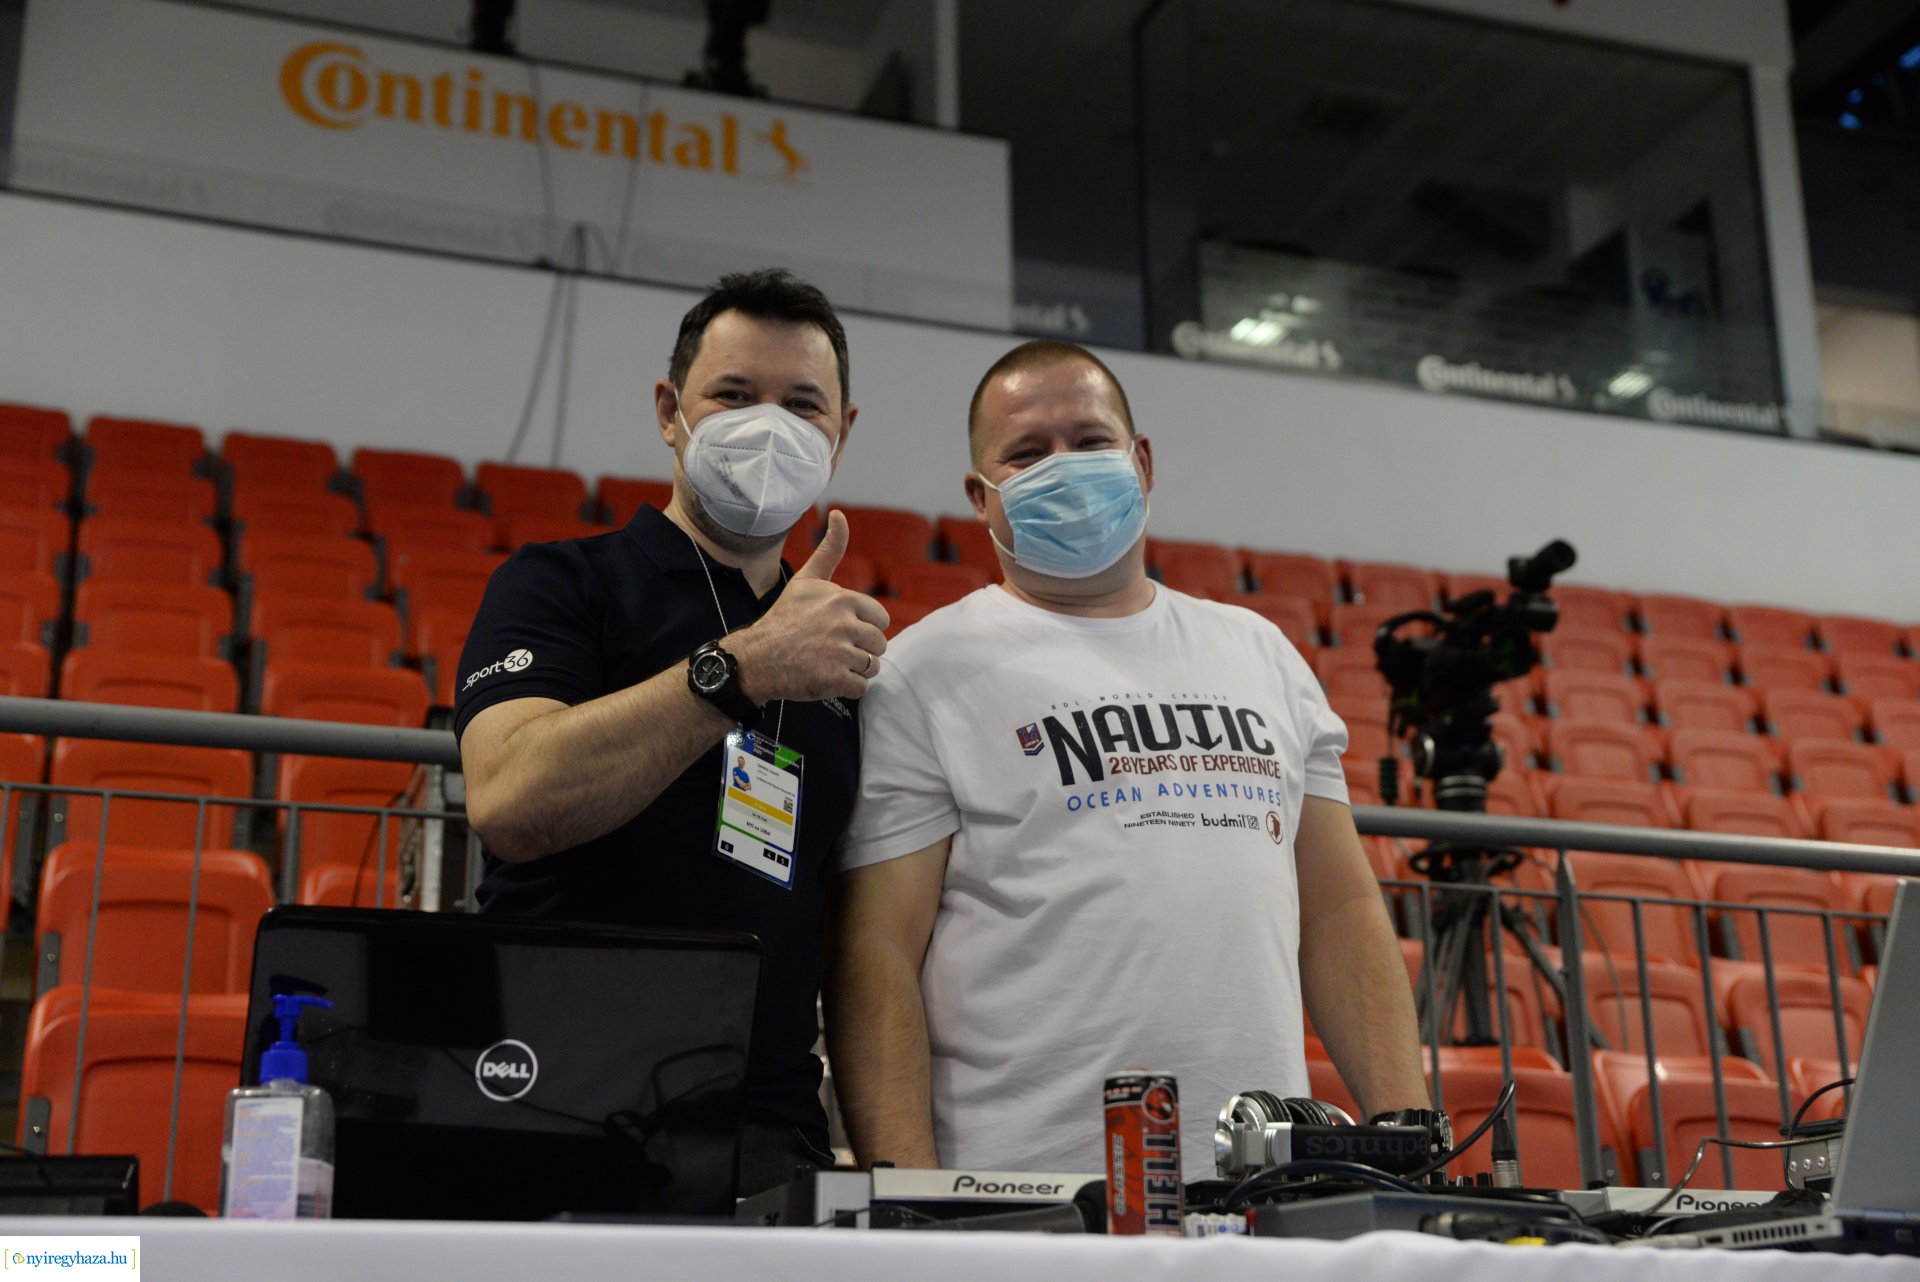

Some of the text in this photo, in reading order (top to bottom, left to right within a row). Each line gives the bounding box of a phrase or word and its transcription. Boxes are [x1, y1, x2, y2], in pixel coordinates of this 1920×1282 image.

[280, 41, 740, 174] Continental
[1042, 703, 1275, 786] NAUTIC
[1180, 755, 1198, 772] OF
[1203, 755, 1281, 780] EXPERIENCE
[1067, 783, 1281, 812] OCEAN ADVENTURES
[1124, 818, 1196, 829] NINETEEN NINETY
[1140, 810, 1195, 820] ESTABLISHED
[1201, 813, 1246, 829] budmil
[482, 1061, 531, 1079] DELL
[1306, 1135, 1429, 1161] echnics
[952, 1174, 1065, 1196] Pioneer
[1142, 1129, 1182, 1230] HELL
[1676, 1194, 1761, 1211] Pione
